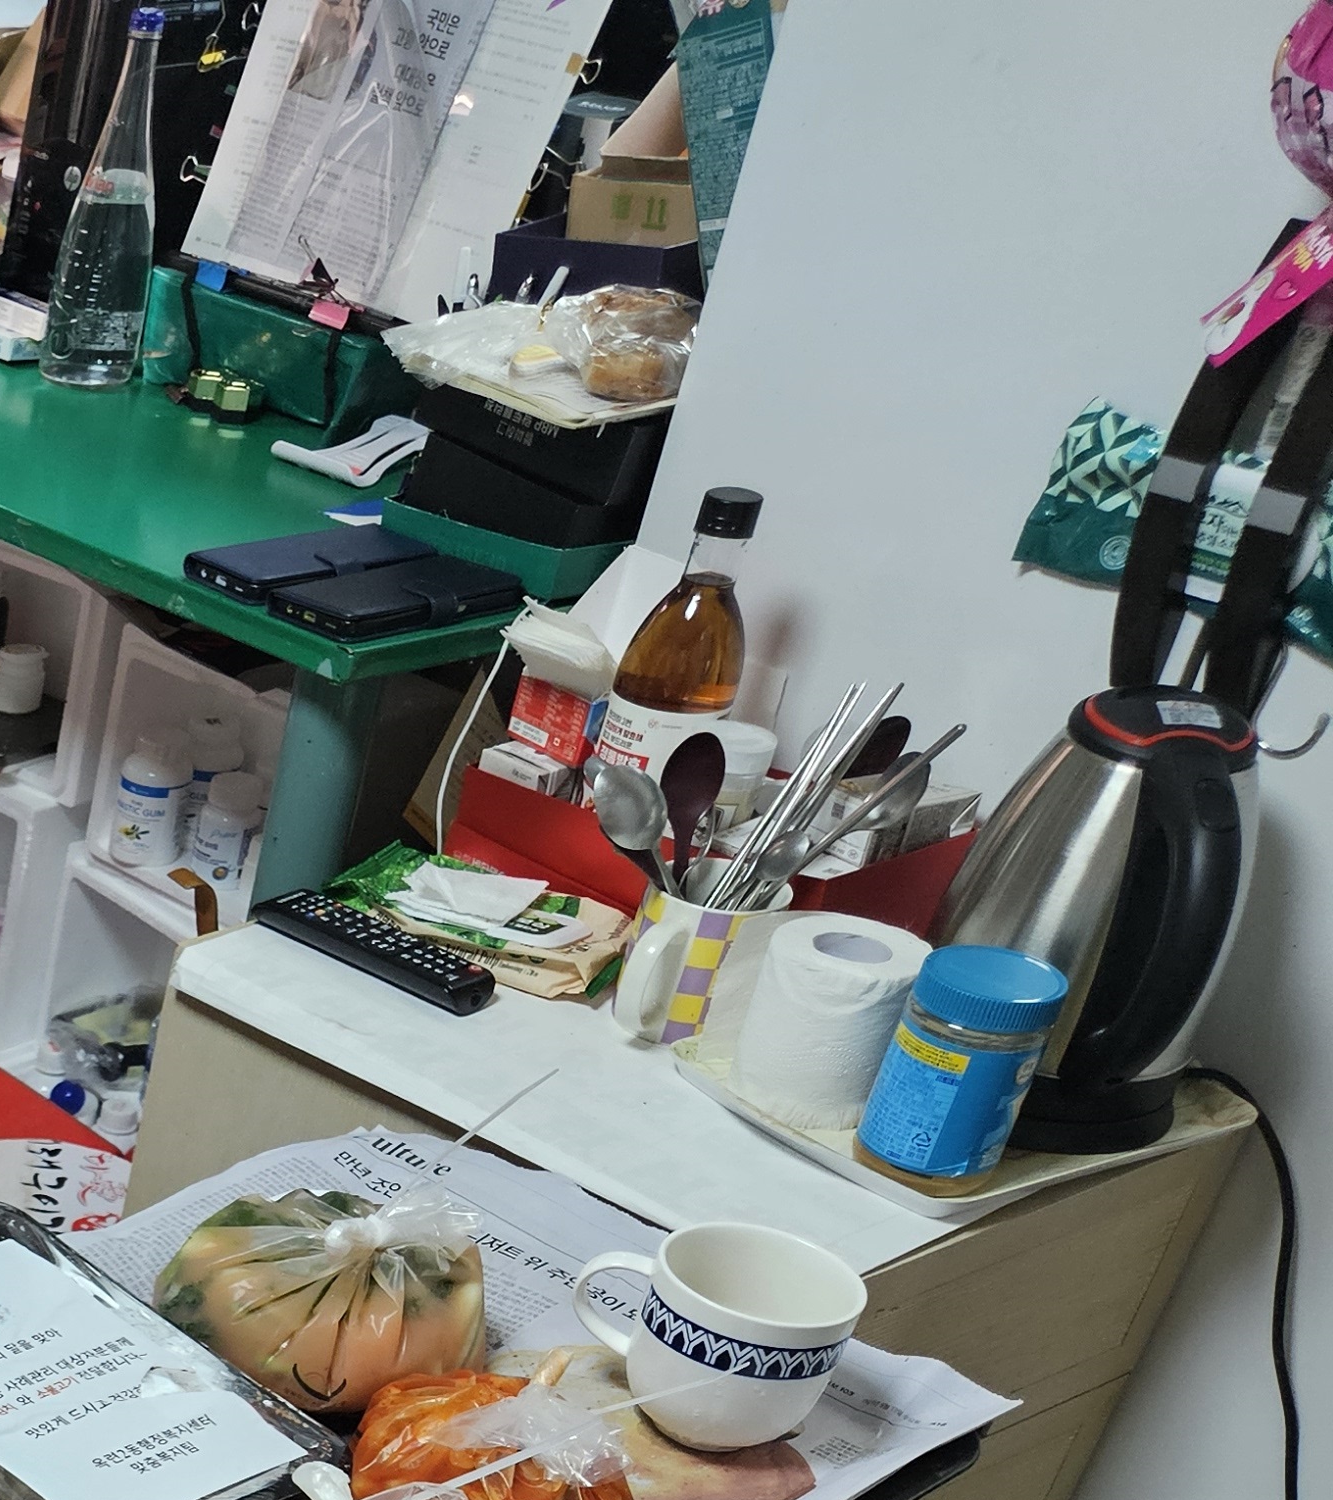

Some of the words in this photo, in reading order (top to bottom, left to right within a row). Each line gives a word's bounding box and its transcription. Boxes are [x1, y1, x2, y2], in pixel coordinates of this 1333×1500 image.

[427, 8, 461, 36] 국민은
[419, 32, 451, 61] 앞으로
[333, 1150, 371, 1181] 만년
[524, 1255, 549, 1272] 위
[6, 1336, 36, 1357] 달을
[31, 1327, 63, 1346] 맞아
[4, 1362, 60, 1393] 사례관리
[54, 1336, 136, 1371] 대상자분들께
[15, 1394, 36, 1407] 와
[24, 1414, 72, 1440] 맛있게
[67, 1399, 113, 1422] 드시고
[91, 1413, 218, 1471] 옥련2동행정복지센터
[129, 1440, 201, 1476] 맞춤복지팀
